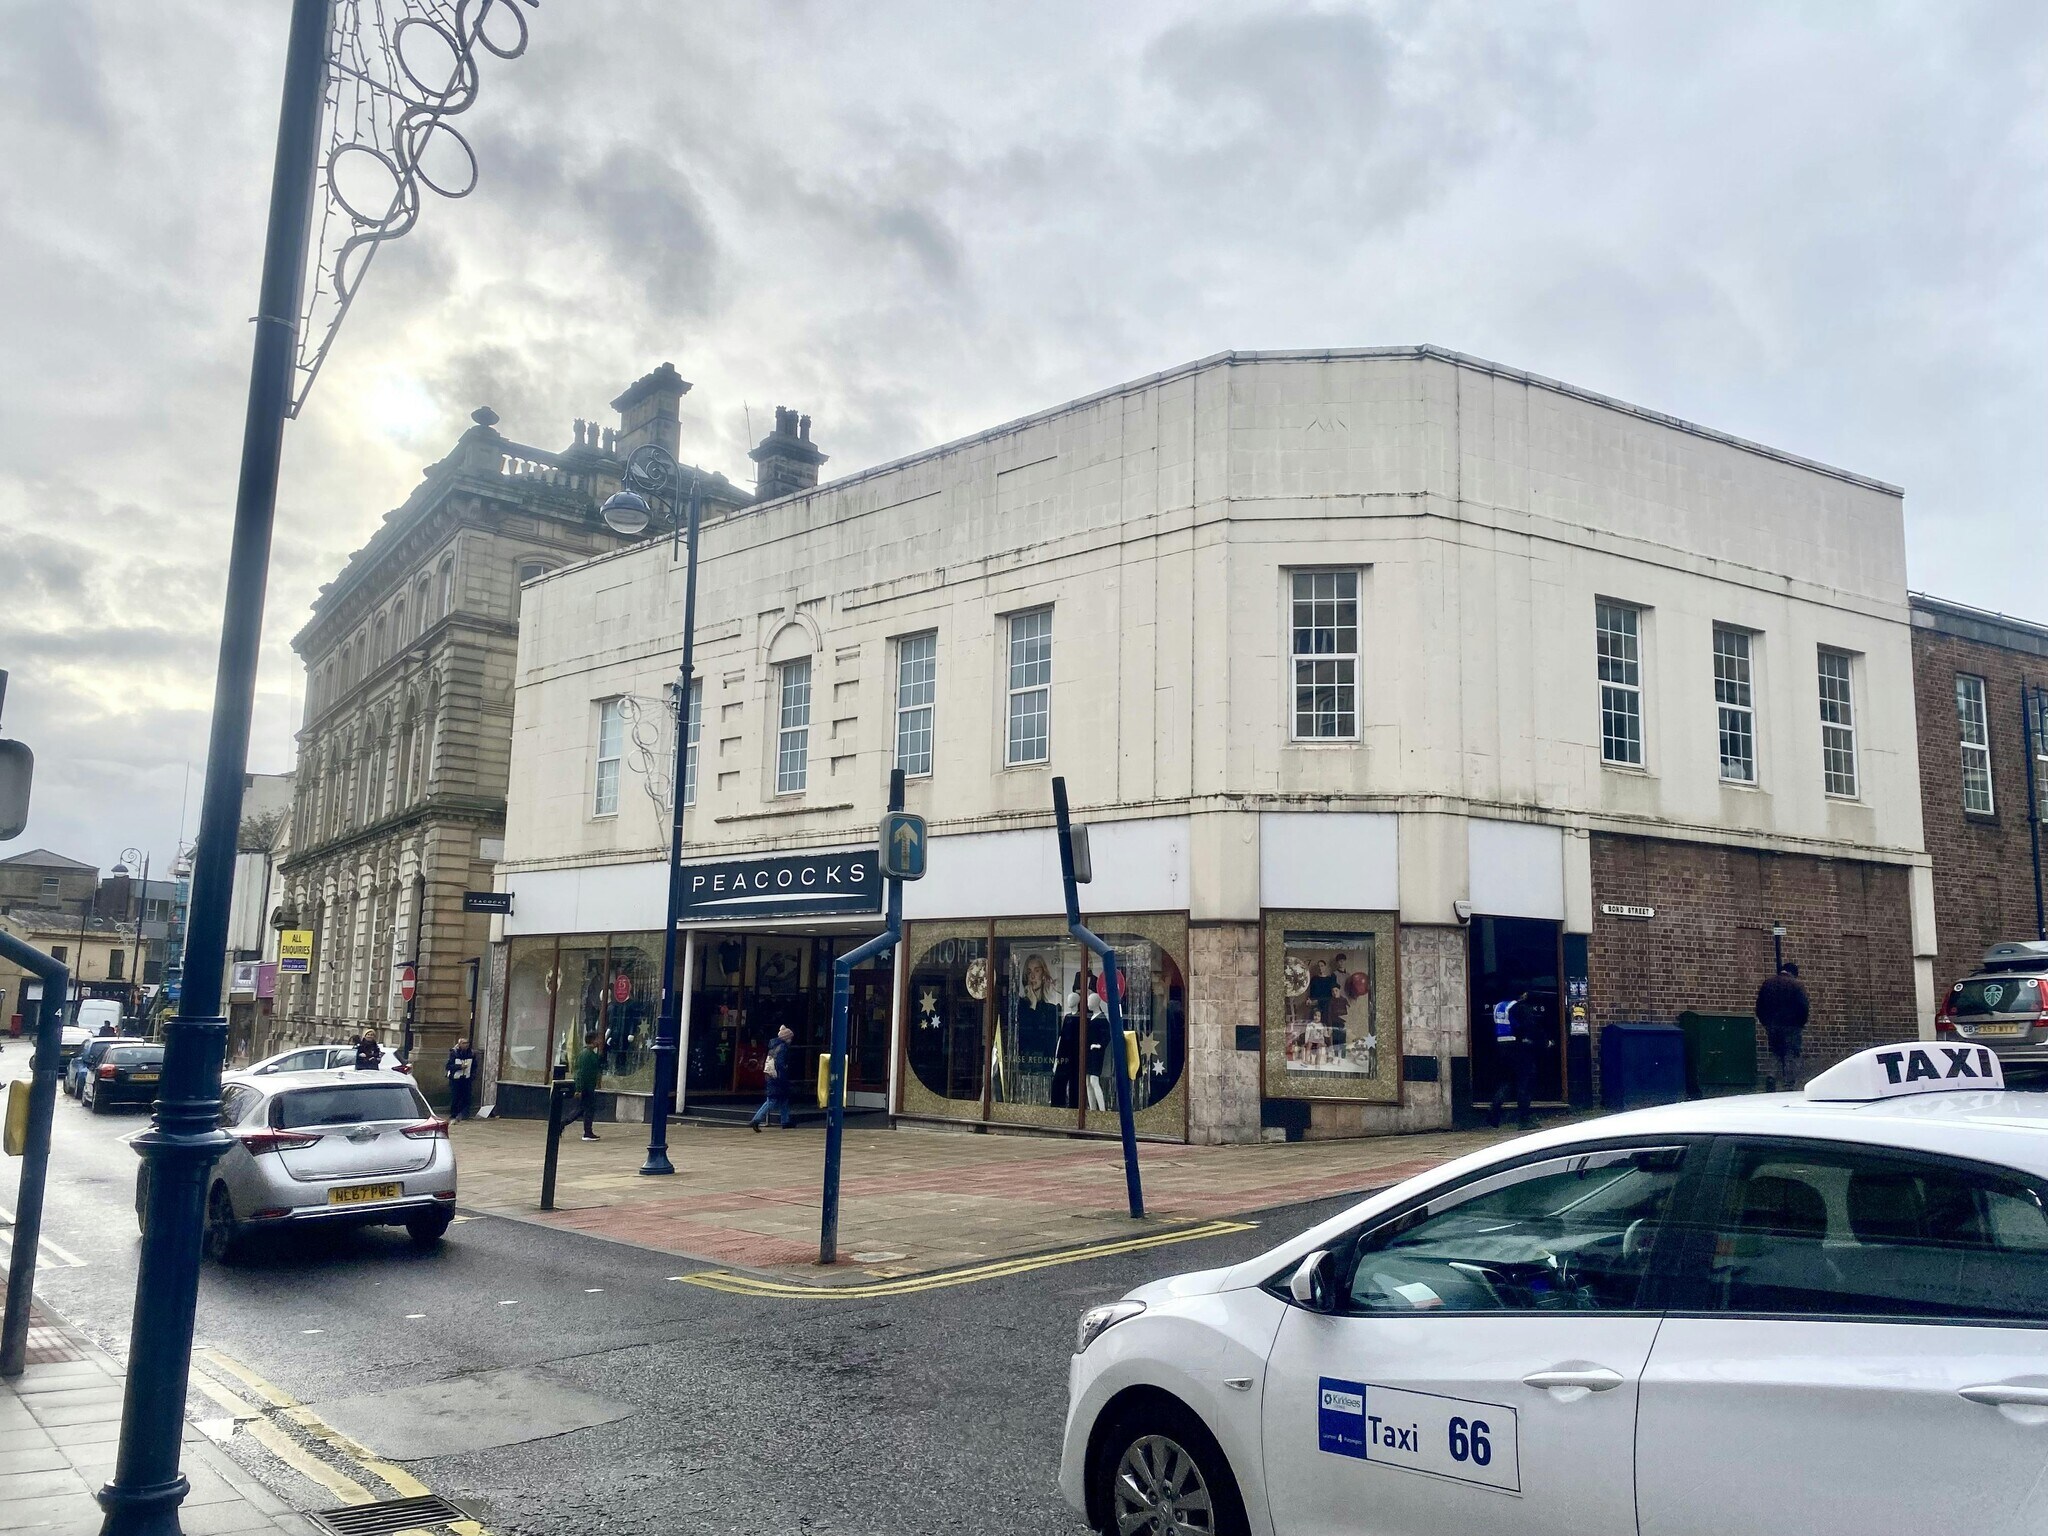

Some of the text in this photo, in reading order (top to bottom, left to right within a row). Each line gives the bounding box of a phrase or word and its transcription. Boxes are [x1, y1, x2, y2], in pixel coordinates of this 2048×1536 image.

[692, 863, 865, 892] PEACOCKS
[1607, 905, 1649, 915] BOND STREET
[291, 934, 302, 943] ALL
[281, 945, 310, 955] ENQUIRIES
[54, 1008, 63, 1018] 4
[1876, 1048, 1994, 1084] TAXI
[1332, 1393, 1361, 1408] Kirklees
[1337, 1433, 1343, 1443] 4
[1368, 1415, 1492, 1466] Taxi 66
